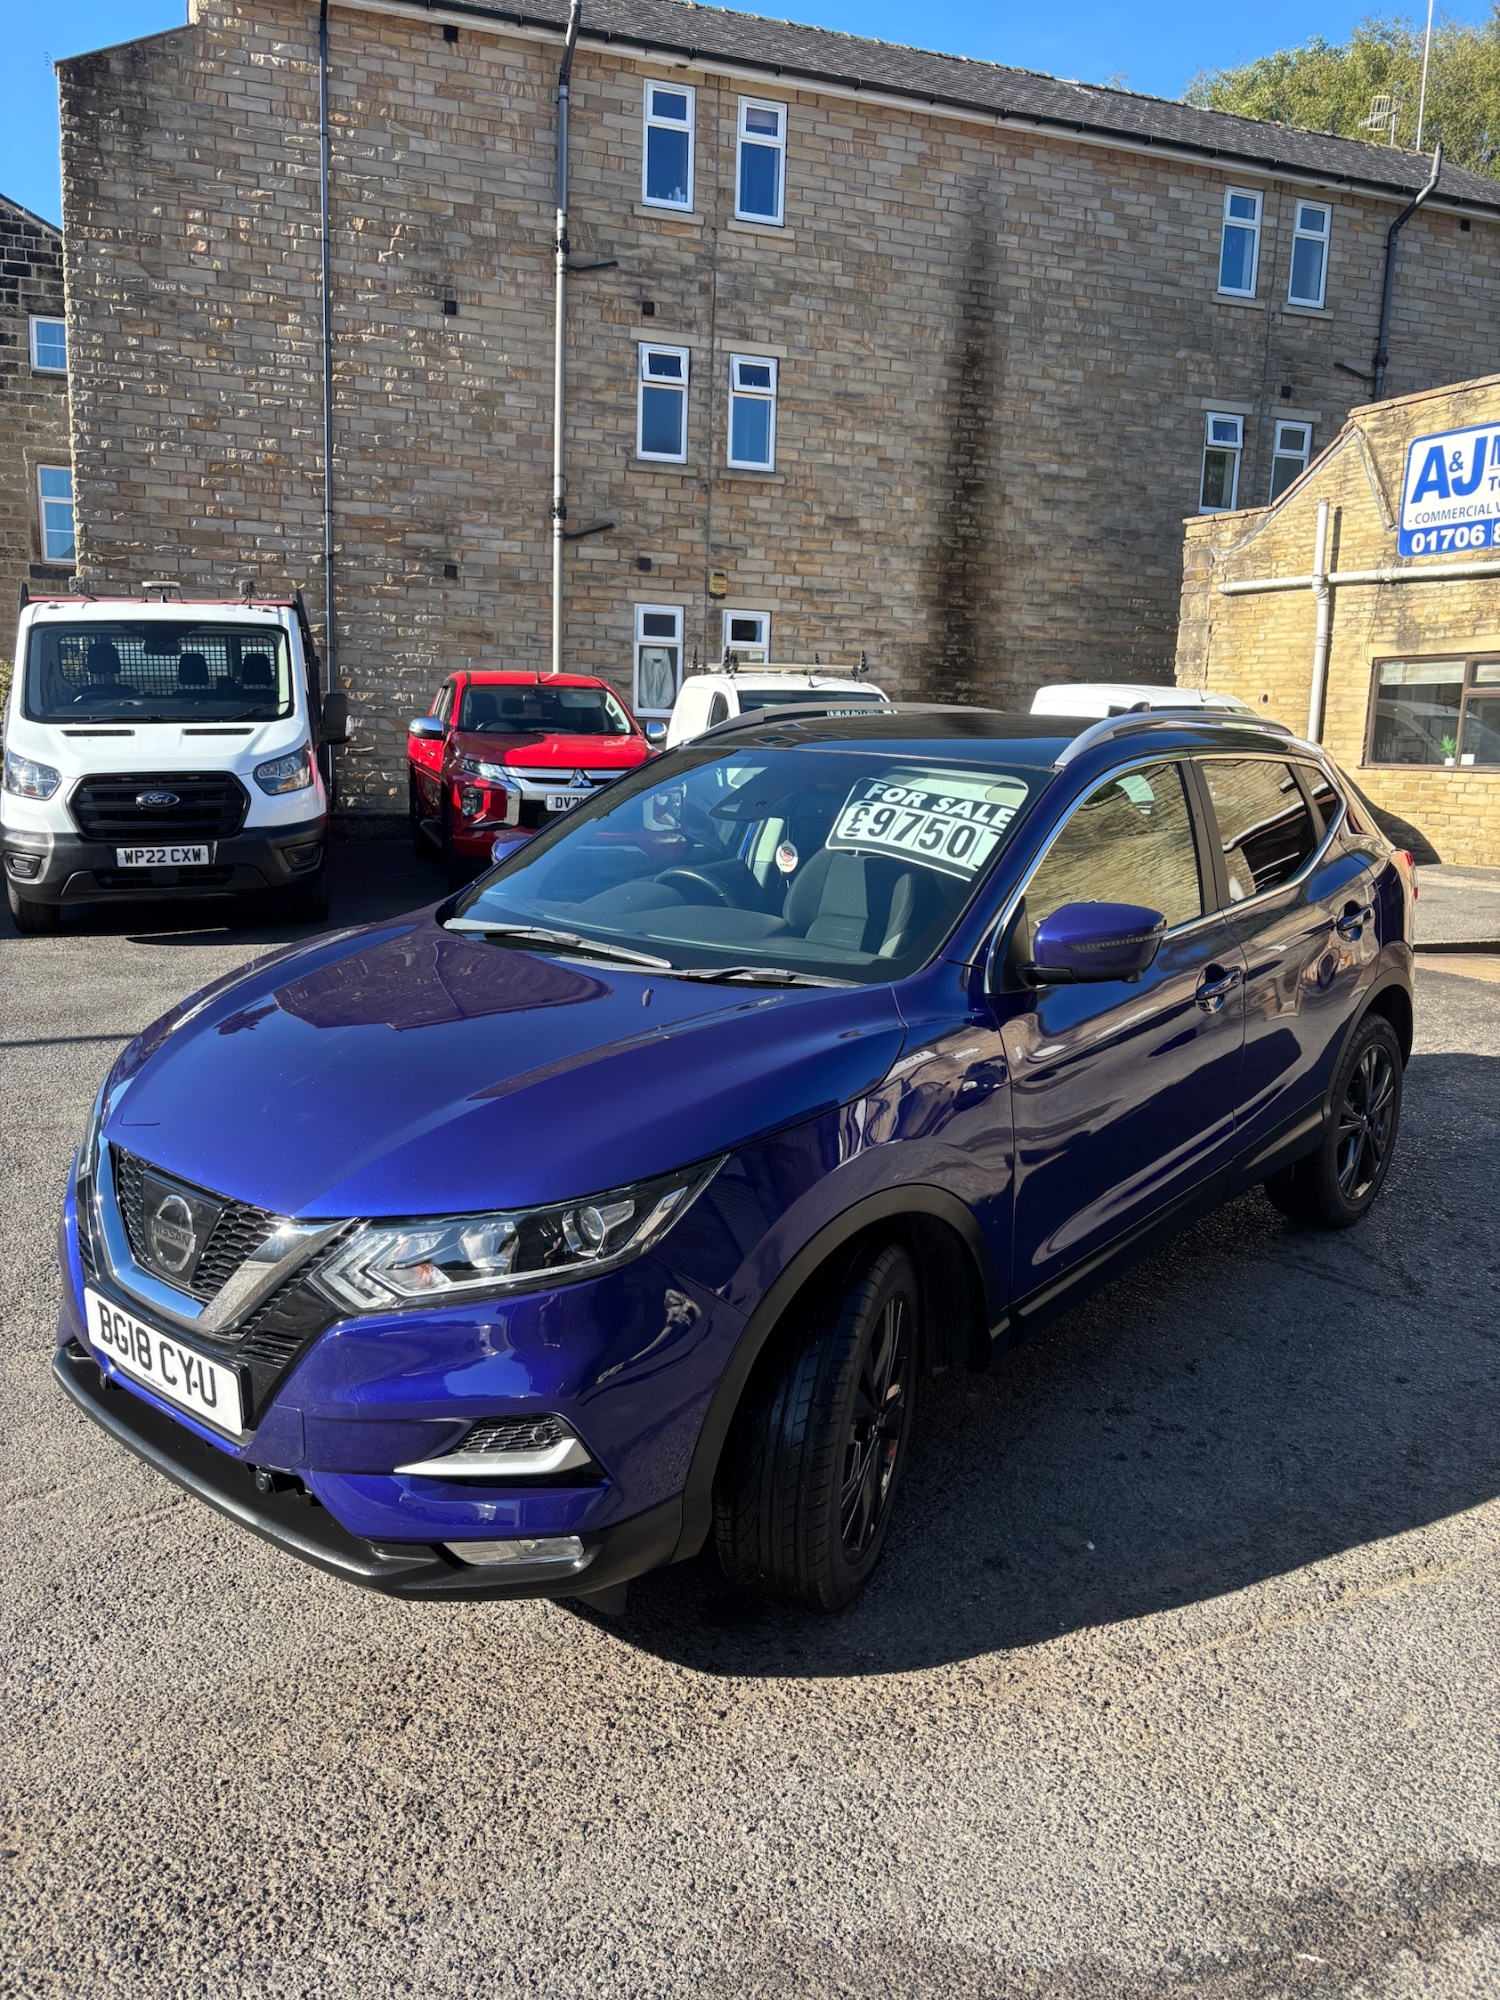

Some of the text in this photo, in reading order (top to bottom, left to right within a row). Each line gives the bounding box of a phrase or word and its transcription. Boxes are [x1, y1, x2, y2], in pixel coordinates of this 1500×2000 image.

[1410, 435, 1488, 504] A&J
[1488, 476, 1500, 492] T
[1414, 503, 1492, 525] COMMERCIAL
[1411, 524, 1486, 554] 01706
[147, 792, 170, 804] Ford
[555, 796, 583, 809] DV2
[863, 783, 1017, 829] FOR SALE
[846, 807, 977, 859] £9750
[124, 848, 201, 864] WP22 CXW
[152, 1222, 190, 1247] NISSAN
[97, 1299, 217, 1408] BG18 CYU
